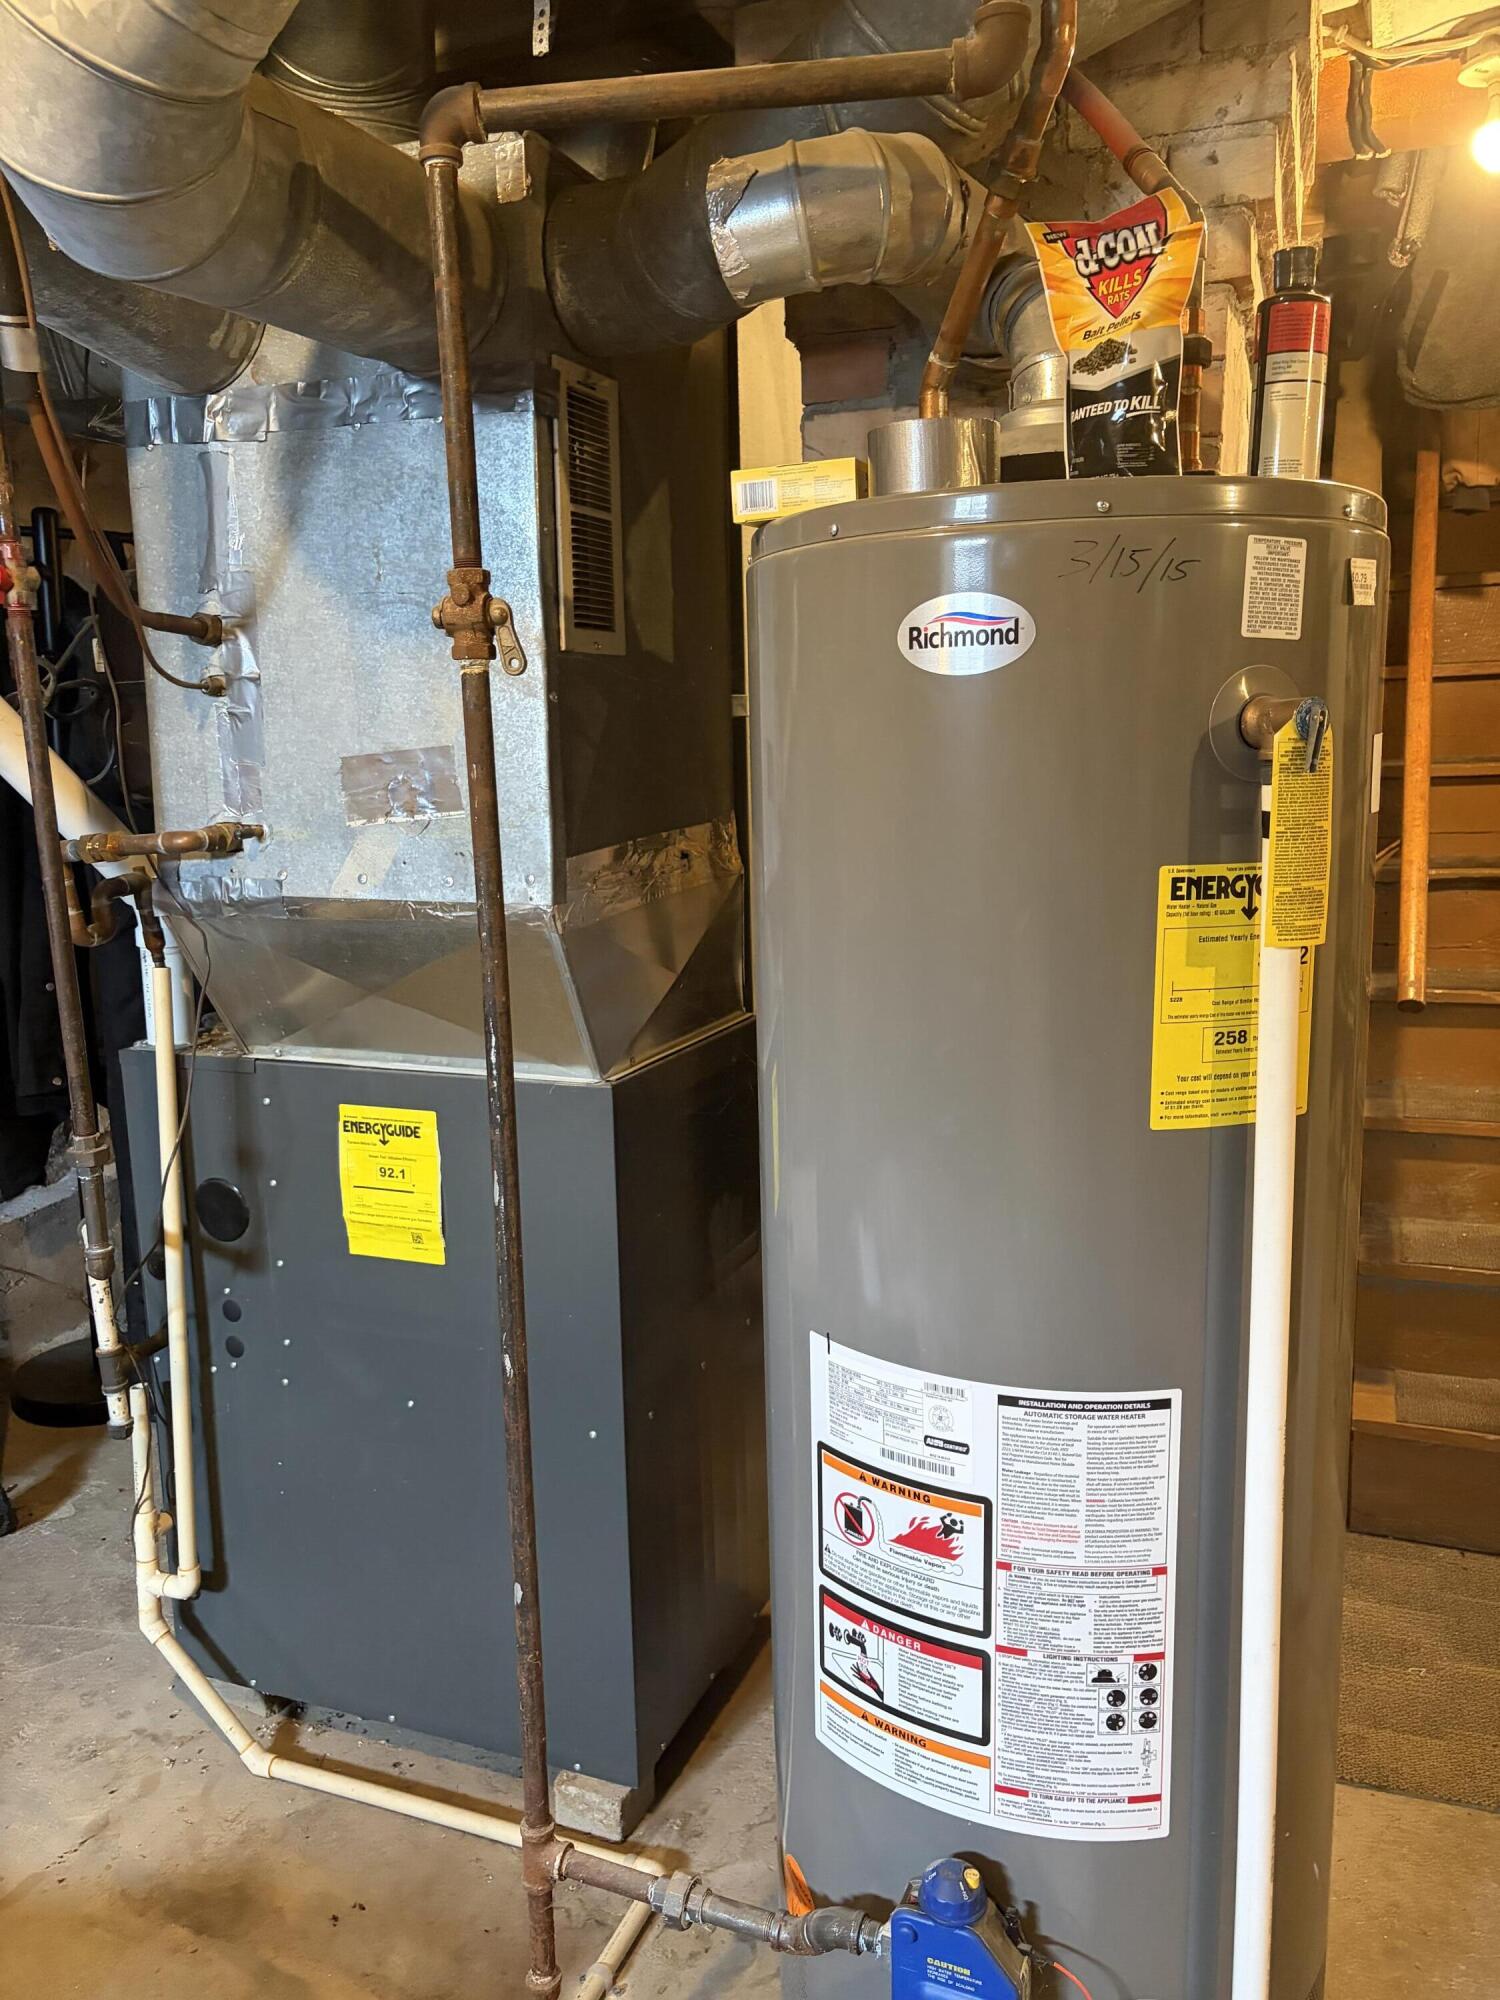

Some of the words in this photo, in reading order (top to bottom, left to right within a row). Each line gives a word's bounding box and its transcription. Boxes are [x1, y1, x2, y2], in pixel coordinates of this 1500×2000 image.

[1045, 231, 1067, 242] NEW
[1098, 268, 1143, 297] KILLS
[1107, 290, 1131, 306] RATS
[1082, 325, 1104, 341] Bait
[1106, 310, 1142, 332] Pellets
[1114, 398, 1129, 412] TO
[1129, 395, 1161, 411] KILL
[1057, 534, 1201, 594] 3/15/15
[908, 618, 1020, 650] Richmond
[1198, 934, 1228, 943] Estimated
[1230, 933, 1248, 942] Yearly
[1214, 1030, 1248, 1046] 258
[1177, 1074, 1189, 1082] Your
[1190, 1074, 1202, 1082] cost
[1203, 1073, 1212, 1081] will
[1214, 1073, 1232, 1082] depend
[1240, 1071, 1250, 1080] your
[343, 1120, 421, 1140] ENERGYGUIDE
[379, 1166, 406, 1180] 92.1
[1018, 1400, 1066, 1410] INSTALLATION
[1024, 1411, 1064, 1420] AUTOMATIC
[872, 1477, 931, 1504] WARNING
[856, 1550, 867, 1559] FIRE
[868, 1556, 879, 1565] AND
[880, 1561, 910, 1577] EXPLOSION
[911, 1572, 936, 1584] HAZARD
[889, 1547, 922, 1563] Flammable
[924, 1559, 947, 1571] Vapors
[853, 1555, 862, 1563] Can
[862, 1560, 876, 1571] result
[882, 1569, 901, 1580] serious
[901, 1576, 916, 1586] injury
[924, 1584, 940, 1593] death
[1013, 1565, 1026, 1573] FOR
[1027, 1567, 1045, 1575] YOUR
[1046, 1569, 1072, 1577] SAFETY
[1116, 1570, 1151, 1578] OPERATING
[932, 1592, 950, 1604] vapors
[961, 1600, 979, 1611] liquids
[959, 1606, 981, 1617] gasoline
[873, 1623, 922, 1652] DANGER
[1042, 1653, 1072, 1662] LIGHTING
[874, 1717, 927, 1748] WARNING
[1097, 1797, 1126, 1805] APPLIANCE
[925, 1871, 937, 1884] LOW
[926, 1957, 971, 1977] CAUTION
[928, 1973, 937, 1981] THE
[955, 1982, 976, 1993] SCALDING
[954, 1973, 984, 1986] TEMPERATURE
